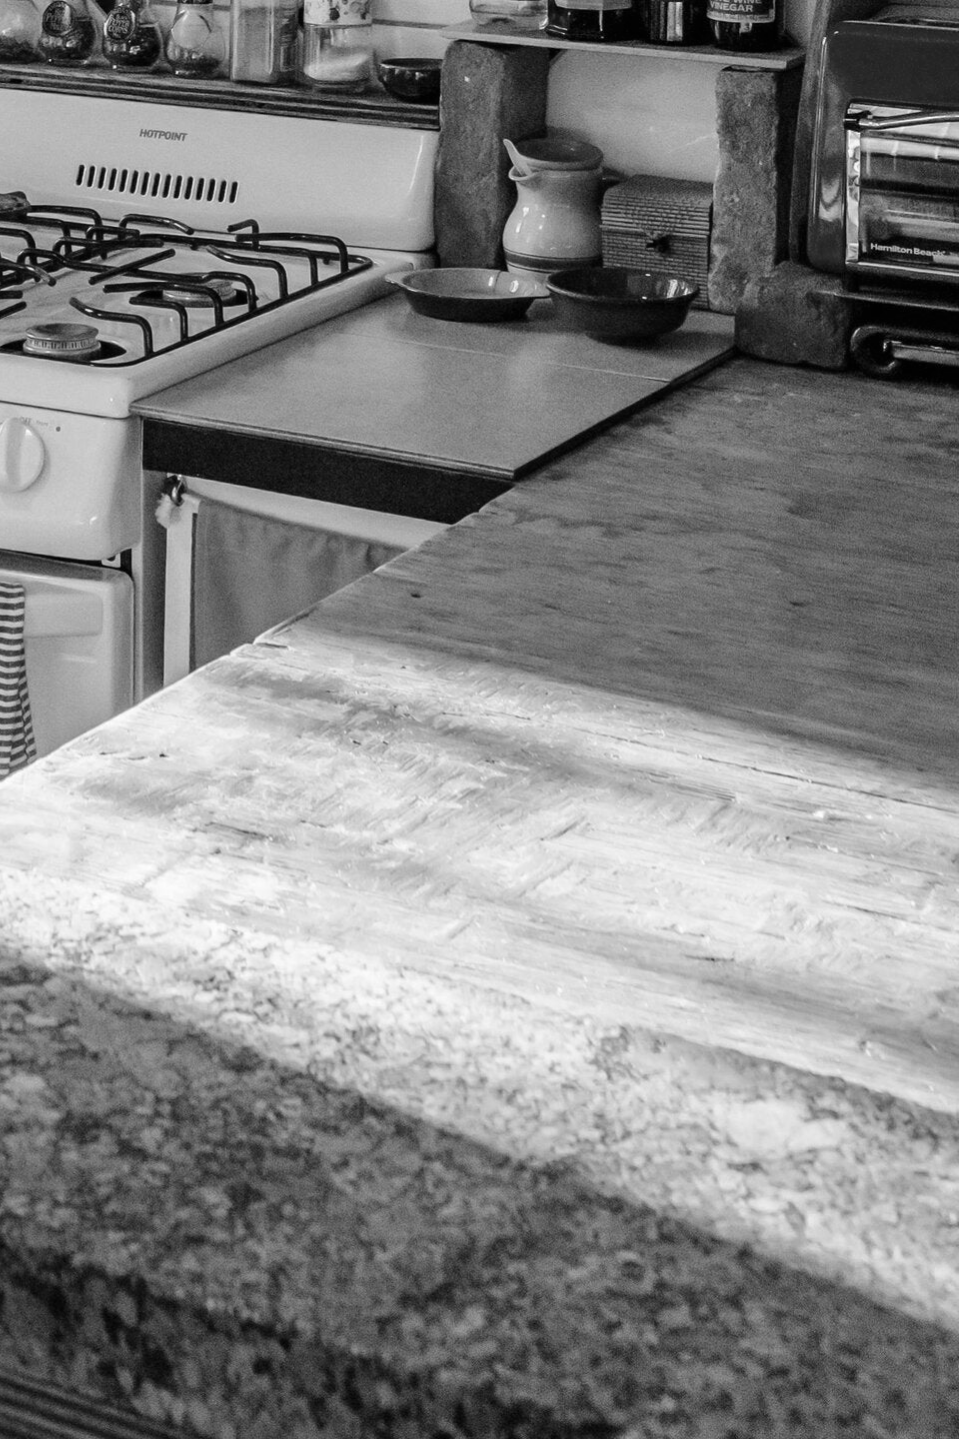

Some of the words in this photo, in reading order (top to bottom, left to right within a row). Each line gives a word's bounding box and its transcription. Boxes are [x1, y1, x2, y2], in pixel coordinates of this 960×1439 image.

[710, 0, 754, 12] VINEGAR
[139, 129, 188, 141] HOTPOINT
[870, 242, 913, 254] Hamilton
